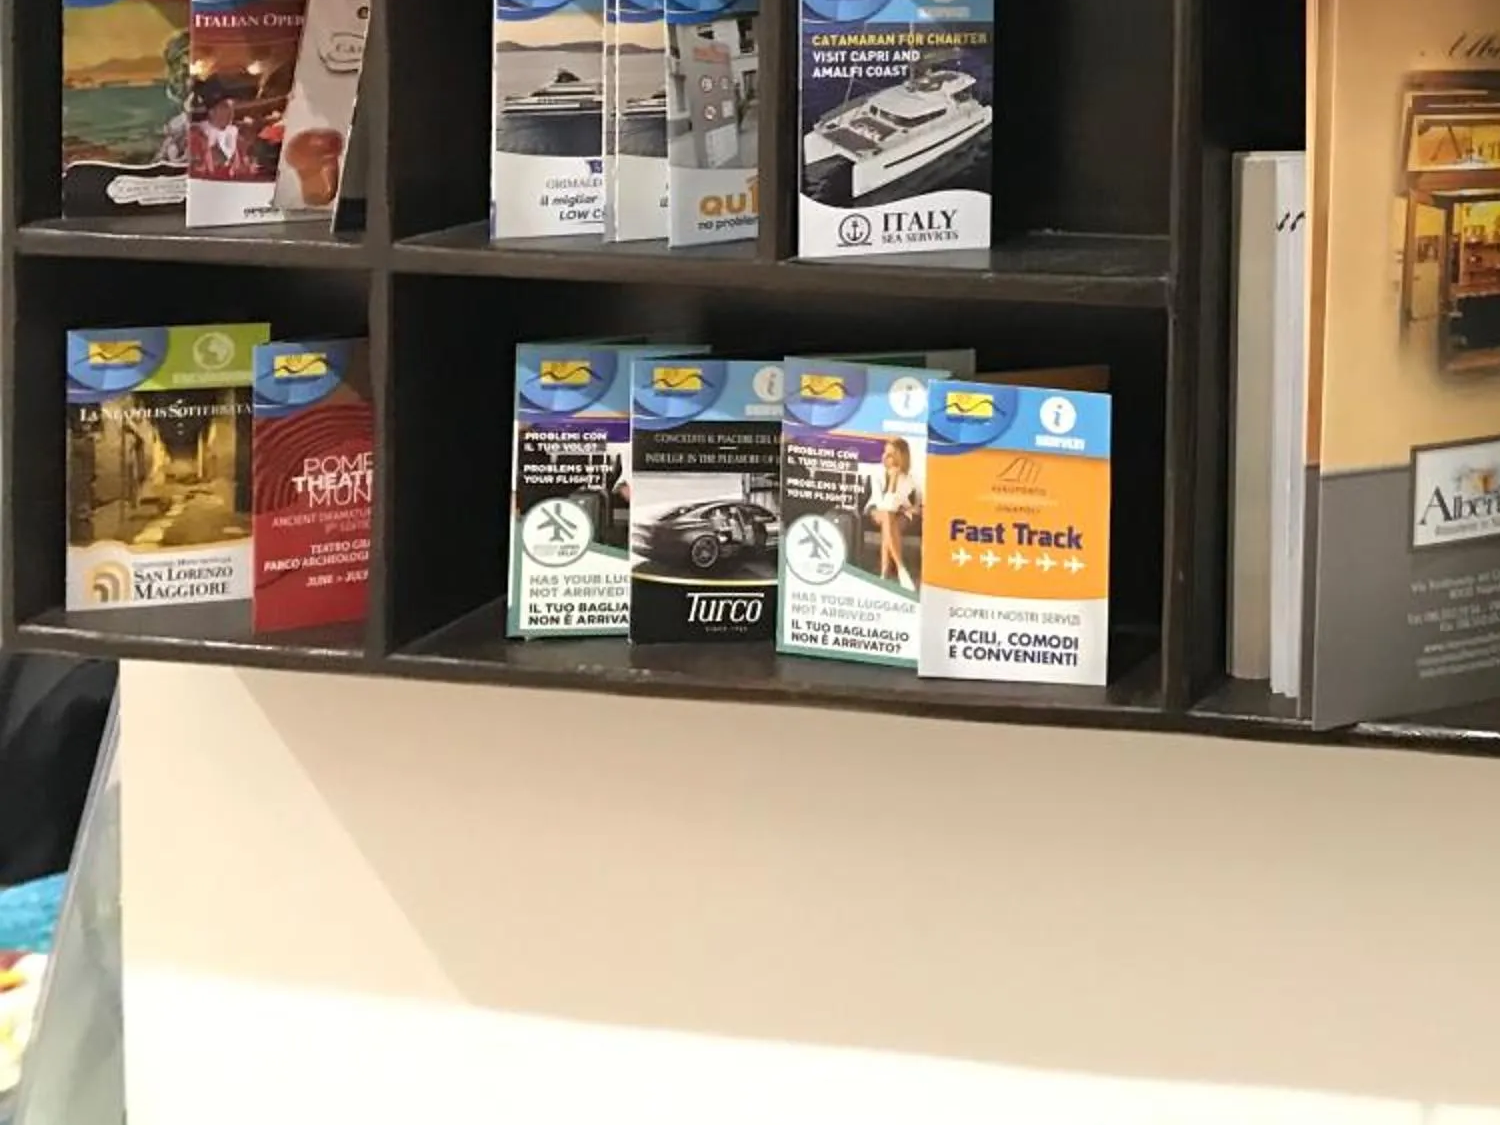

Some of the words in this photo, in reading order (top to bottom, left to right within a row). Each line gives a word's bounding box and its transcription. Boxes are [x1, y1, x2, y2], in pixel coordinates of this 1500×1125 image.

[195, 14, 259, 27] ITALIAN
[812, 33, 895, 47] CATAMARAN
[899, 33, 924, 46] FOR
[927, 32, 988, 46] CHARTER
[813, 50, 847, 64] VISIT
[850, 49, 890, 63] CAPRI
[893, 49, 921, 62] AND
[813, 65, 863, 79] AMALFI
[866, 64, 908, 78] COAST
[552, 193, 598, 209] miglior
[559, 208, 588, 221] LOW
[883, 208, 958, 232] ITALY
[882, 231, 903, 243] SEA
[906, 229, 959, 243] SERVICES
[80, 407, 98, 422] LA
[525, 431, 581, 441] PROBLEMI
[584, 431, 607, 441] CON
[534, 442, 560, 452] TUO
[787, 444, 834, 459] PROBLEMI
[837, 449, 859, 461] CON
[524, 464, 582, 474] PROBLEMS
[585, 463, 613, 474] WITH
[798, 456, 820, 467] TUO
[524, 475, 552, 485] YOUR
[787, 477, 837, 492] PROBLEMS
[787, 489, 812, 500] YOUR
[950, 519, 1007, 545] Fast
[1013, 523, 1083, 550] Track
[135, 568, 164, 581] SAN
[167, 566, 234, 581] LORENZO
[530, 575, 559, 585] HAS
[564, 575, 600, 585] YOUR
[134, 581, 230, 600] MAGGIORE
[530, 587, 558, 598] NOT
[529, 603, 542, 613] IL
[545, 603, 575, 613] TUO
[687, 591, 765, 623] Turco
[949, 606, 992, 620] SCOPRI
[998, 609, 1039, 623] NOSTRI
[528, 614, 560, 625] NON
[792, 619, 802, 630] IL
[805, 621, 831, 633] TUO
[834, 624, 910, 642] BAGLIAGLIO
[791, 632, 819, 644] NON
[832, 636, 902, 653] ARRIVATO?
[948, 628, 1001, 647] FACILI,
[1007, 632, 1079, 650] COMODI
[949, 645, 957, 659] E
[962, 646, 1078, 666] CONVENIENTI
